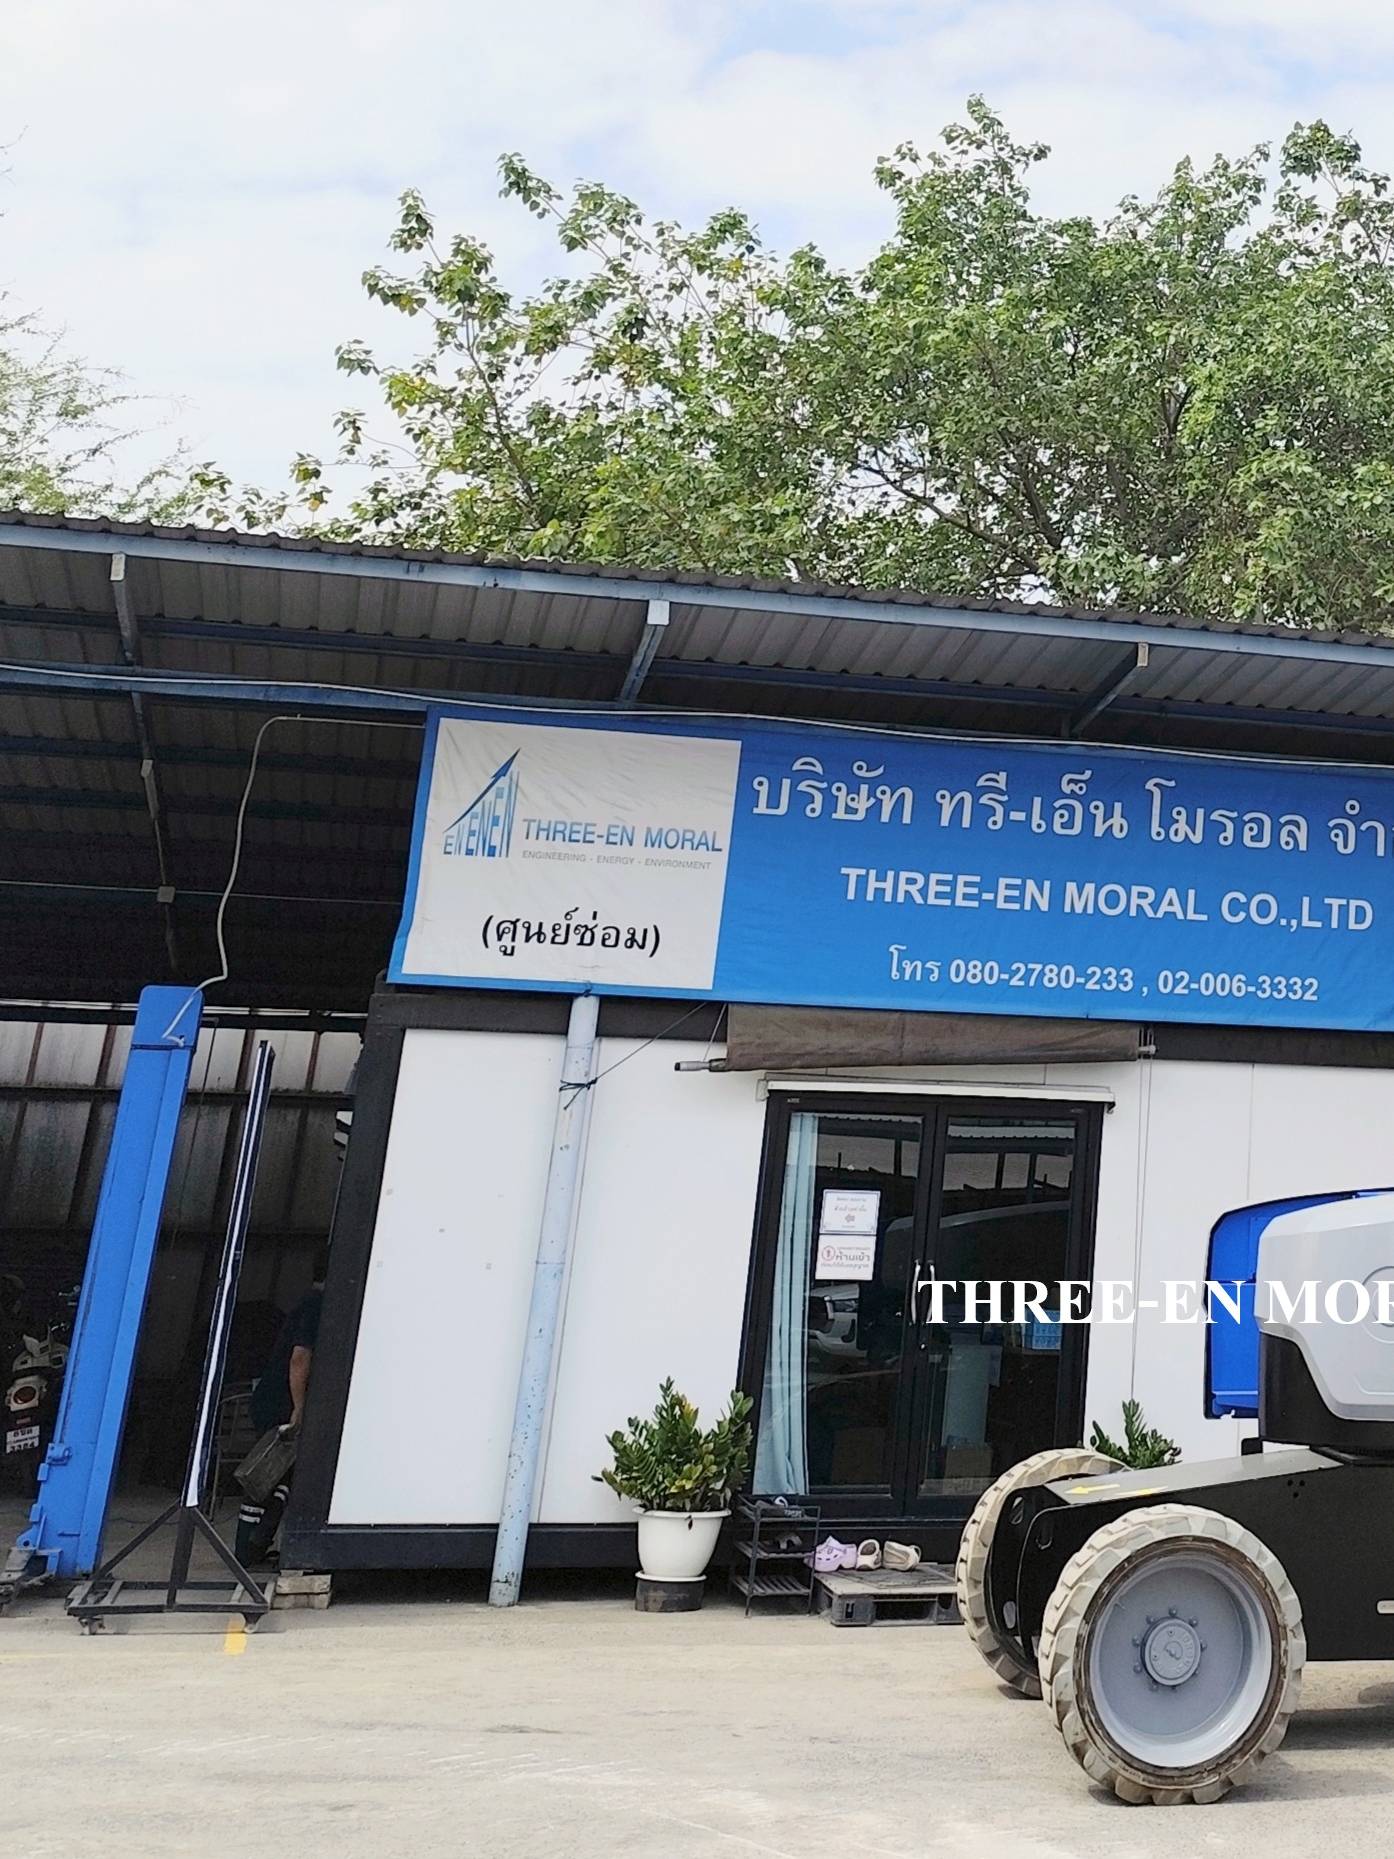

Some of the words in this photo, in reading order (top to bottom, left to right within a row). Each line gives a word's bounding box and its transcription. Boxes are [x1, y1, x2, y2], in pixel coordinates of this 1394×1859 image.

[752, 756, 914, 825] บริษัท
[935, 770, 1129, 839] ทรี-เอ็น
[1145, 777, 1308, 851] โมรอล
[521, 850, 587, 863] ENGINEERING
[596, 855, 636, 866] ENERGY
[644, 858, 712, 871] ENVIRONMENT
[522, 817, 636, 848] THREE-EN
[643, 826, 723, 853] MORAL
[840, 867, 1051, 912] THREE-EN
[1063, 880, 1209, 922] MORAL
[1220, 890, 1374, 932] CO.,LTD
[481, 907, 661, 959] (ศูนย์ซ่อม)
[888, 944, 942, 982] โทร
[949, 958, 1134, 992] 080-2780-233
[1157, 969, 1319, 1001] 02-006-3332
